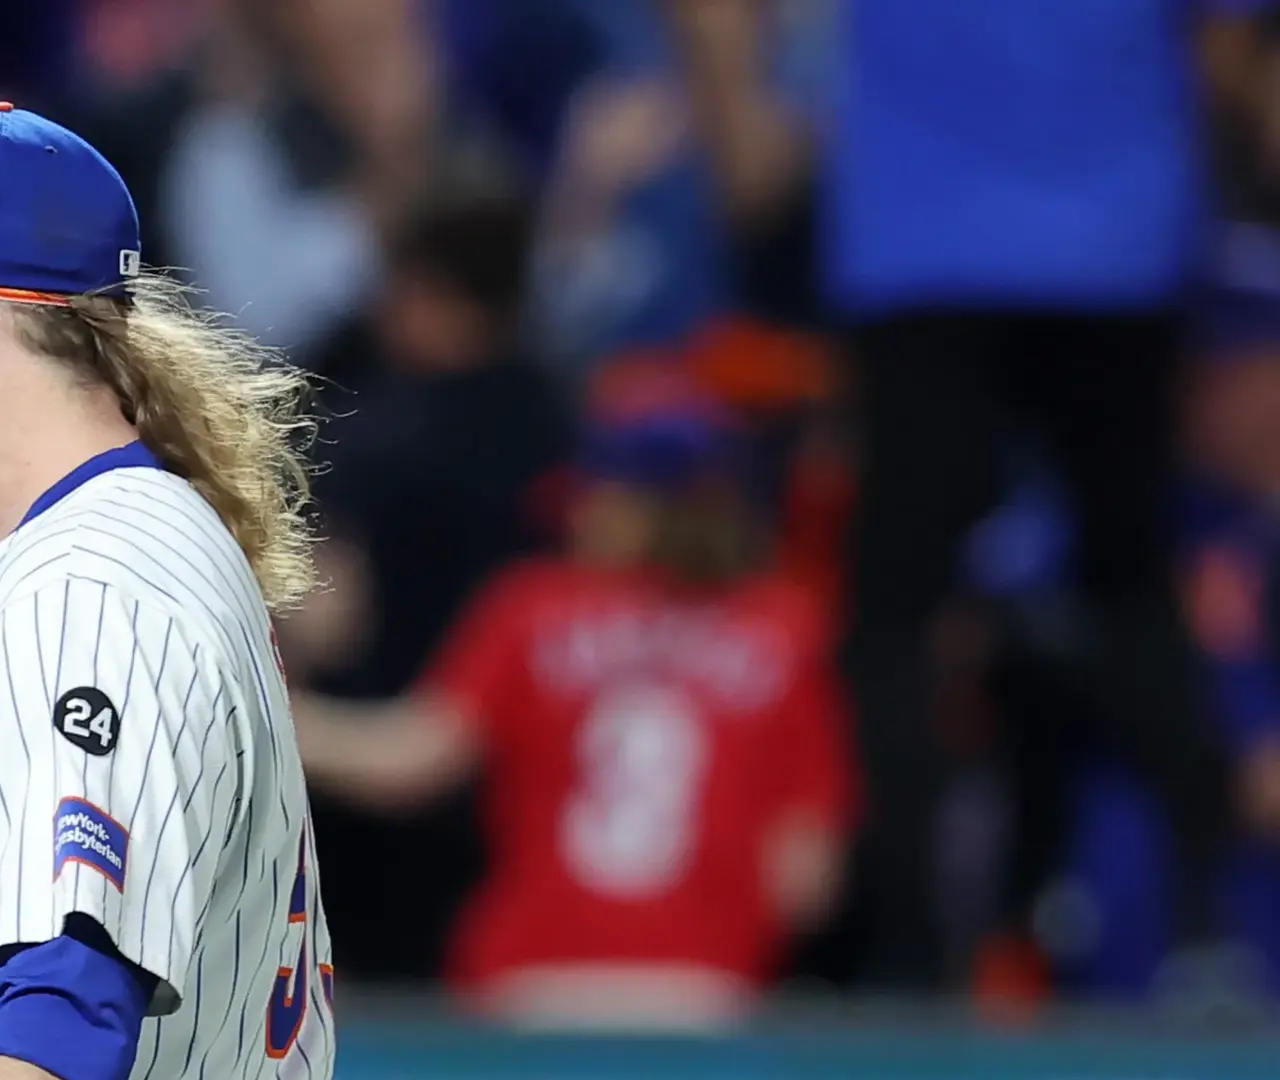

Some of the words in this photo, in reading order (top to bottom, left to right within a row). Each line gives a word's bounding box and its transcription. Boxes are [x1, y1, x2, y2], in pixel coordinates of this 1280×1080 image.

[63, 697, 113, 747] 24
[56, 812, 110, 841] ewYork-
[55, 827, 122, 870] esbyterian
